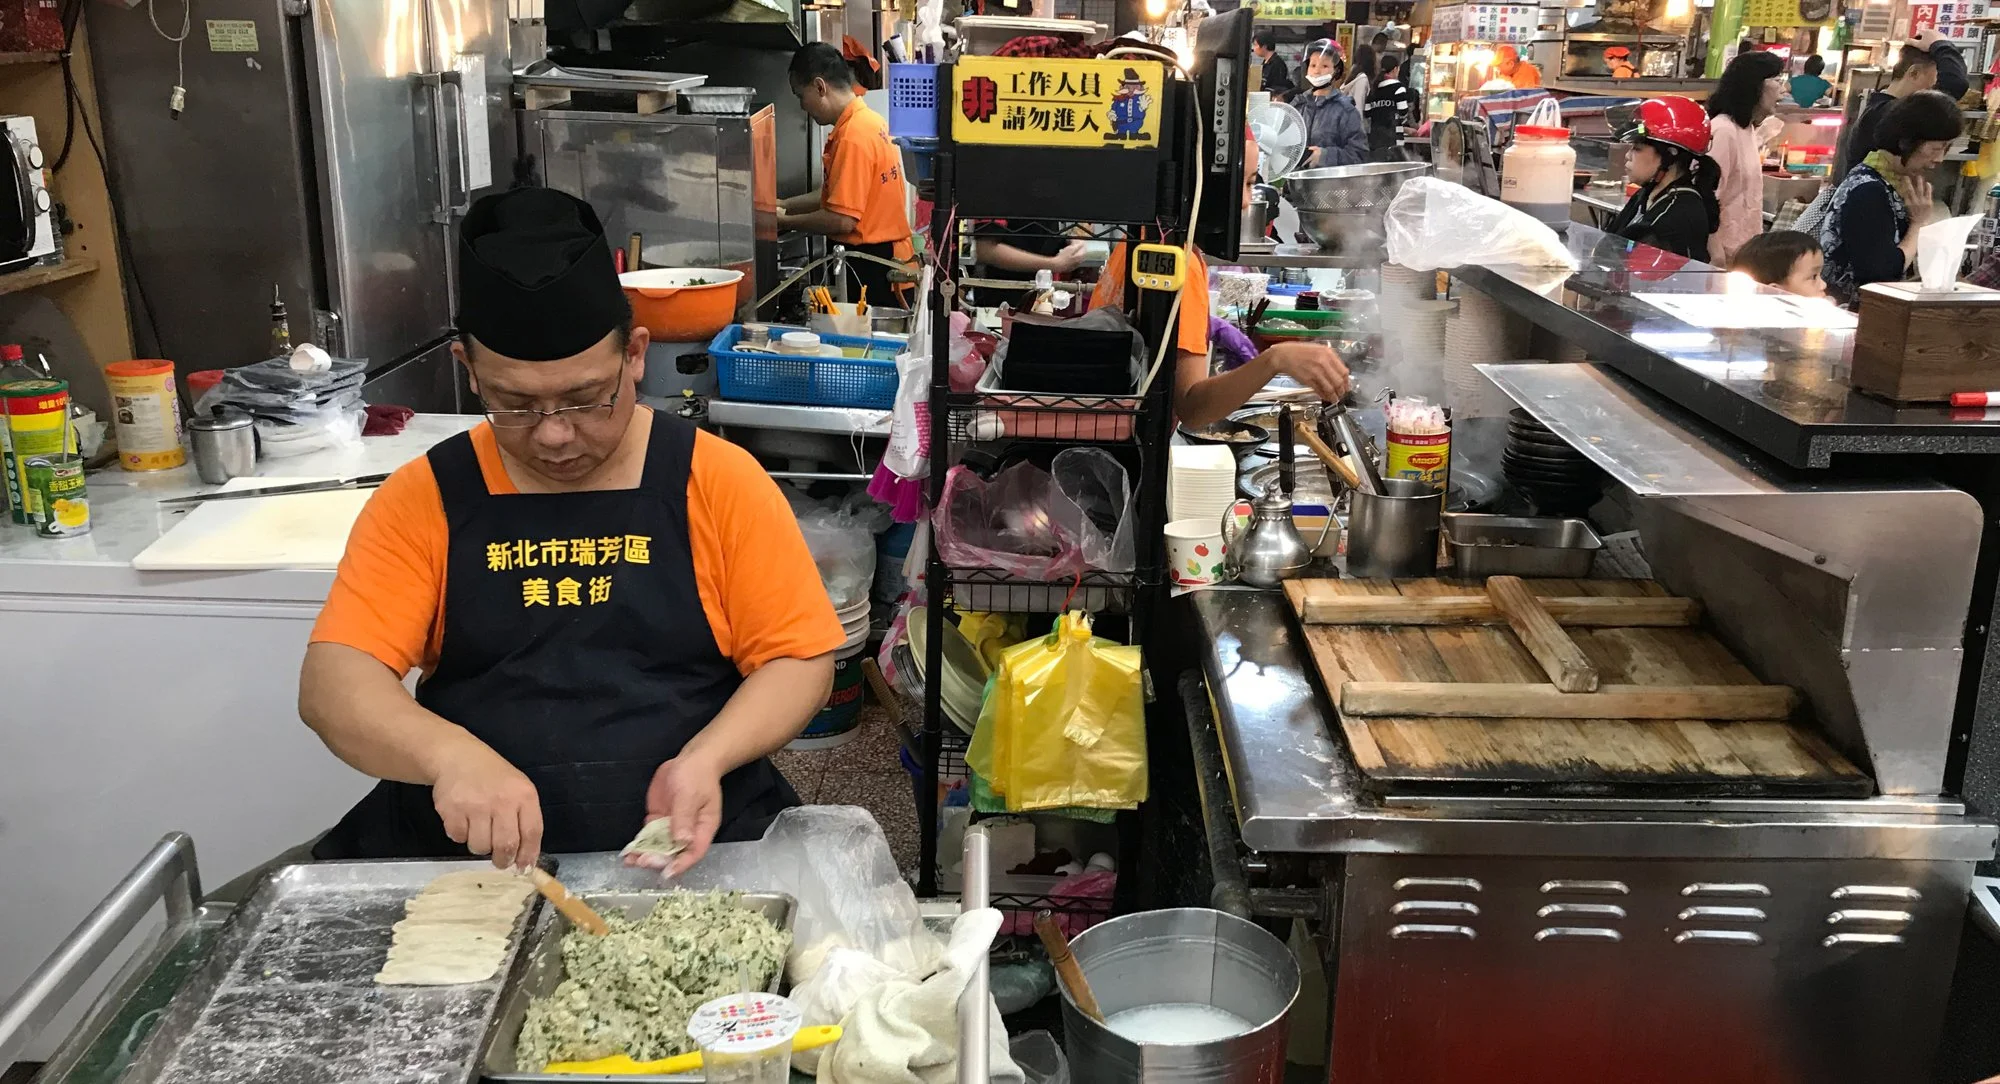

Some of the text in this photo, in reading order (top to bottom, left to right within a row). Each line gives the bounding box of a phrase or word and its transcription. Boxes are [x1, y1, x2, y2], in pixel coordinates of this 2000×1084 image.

[961, 76, 997, 123] 非
[1003, 71, 1101, 99] 工作人員
[1002, 104, 1100, 133] 請勿進入
[486, 534, 652, 572] 新北市瑞芳區
[522, 575, 612, 608] 美食街
